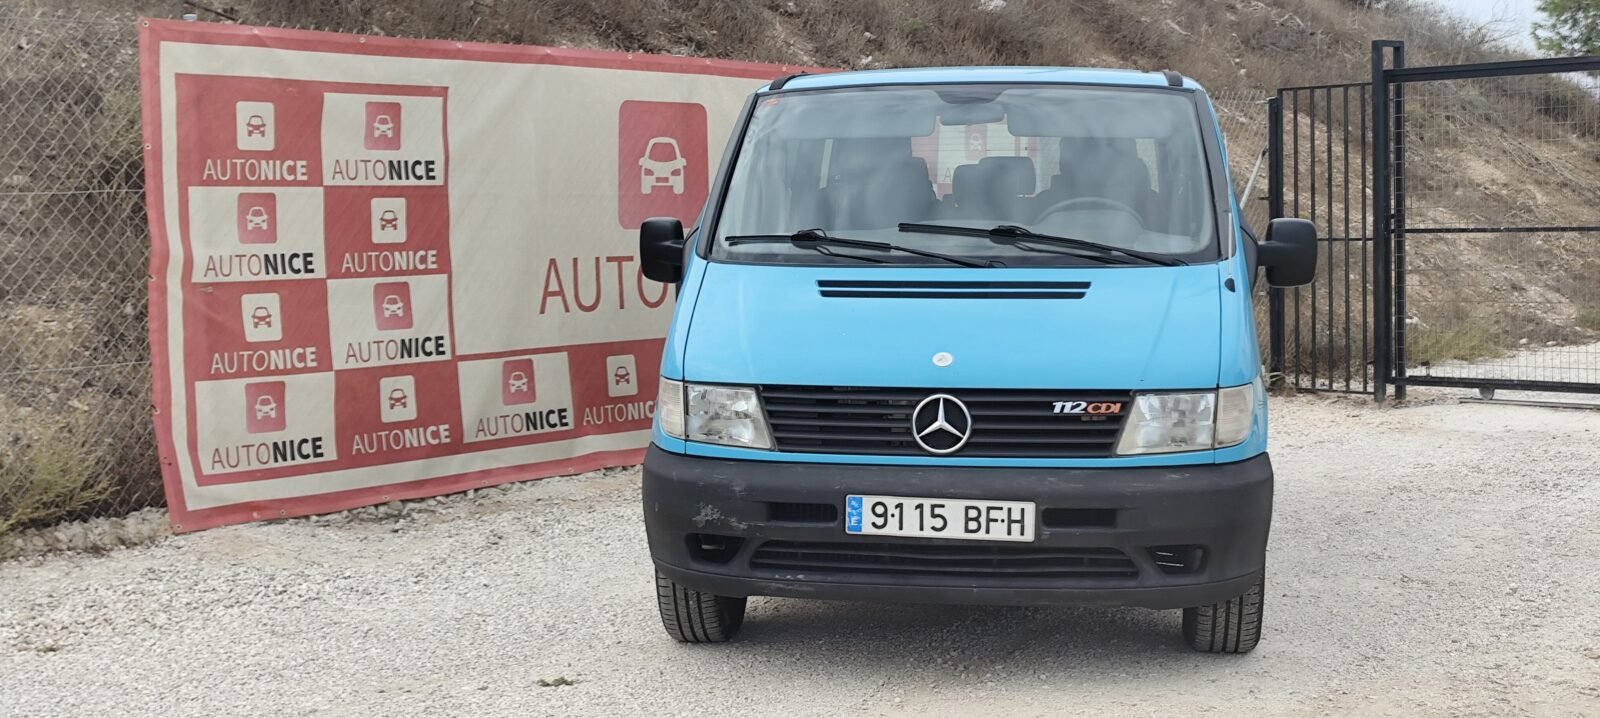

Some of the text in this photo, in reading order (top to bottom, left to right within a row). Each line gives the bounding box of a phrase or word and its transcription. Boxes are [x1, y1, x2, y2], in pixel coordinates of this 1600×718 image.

[203, 159, 308, 181] AUTONICE
[332, 159, 436, 181] AUTONICE
[204, 252, 315, 278] AUTONICE
[341, 250, 438, 273] AUTONICE
[211, 346, 318, 374] AUTONICE
[345, 335, 446, 364] AUTONICE
[475, 407, 569, 438] AUTONICE
[583, 400, 656, 426] AUTONIC
[211, 436, 324, 470] AUTONICE
[352, 424, 451, 455] AUTONICE
